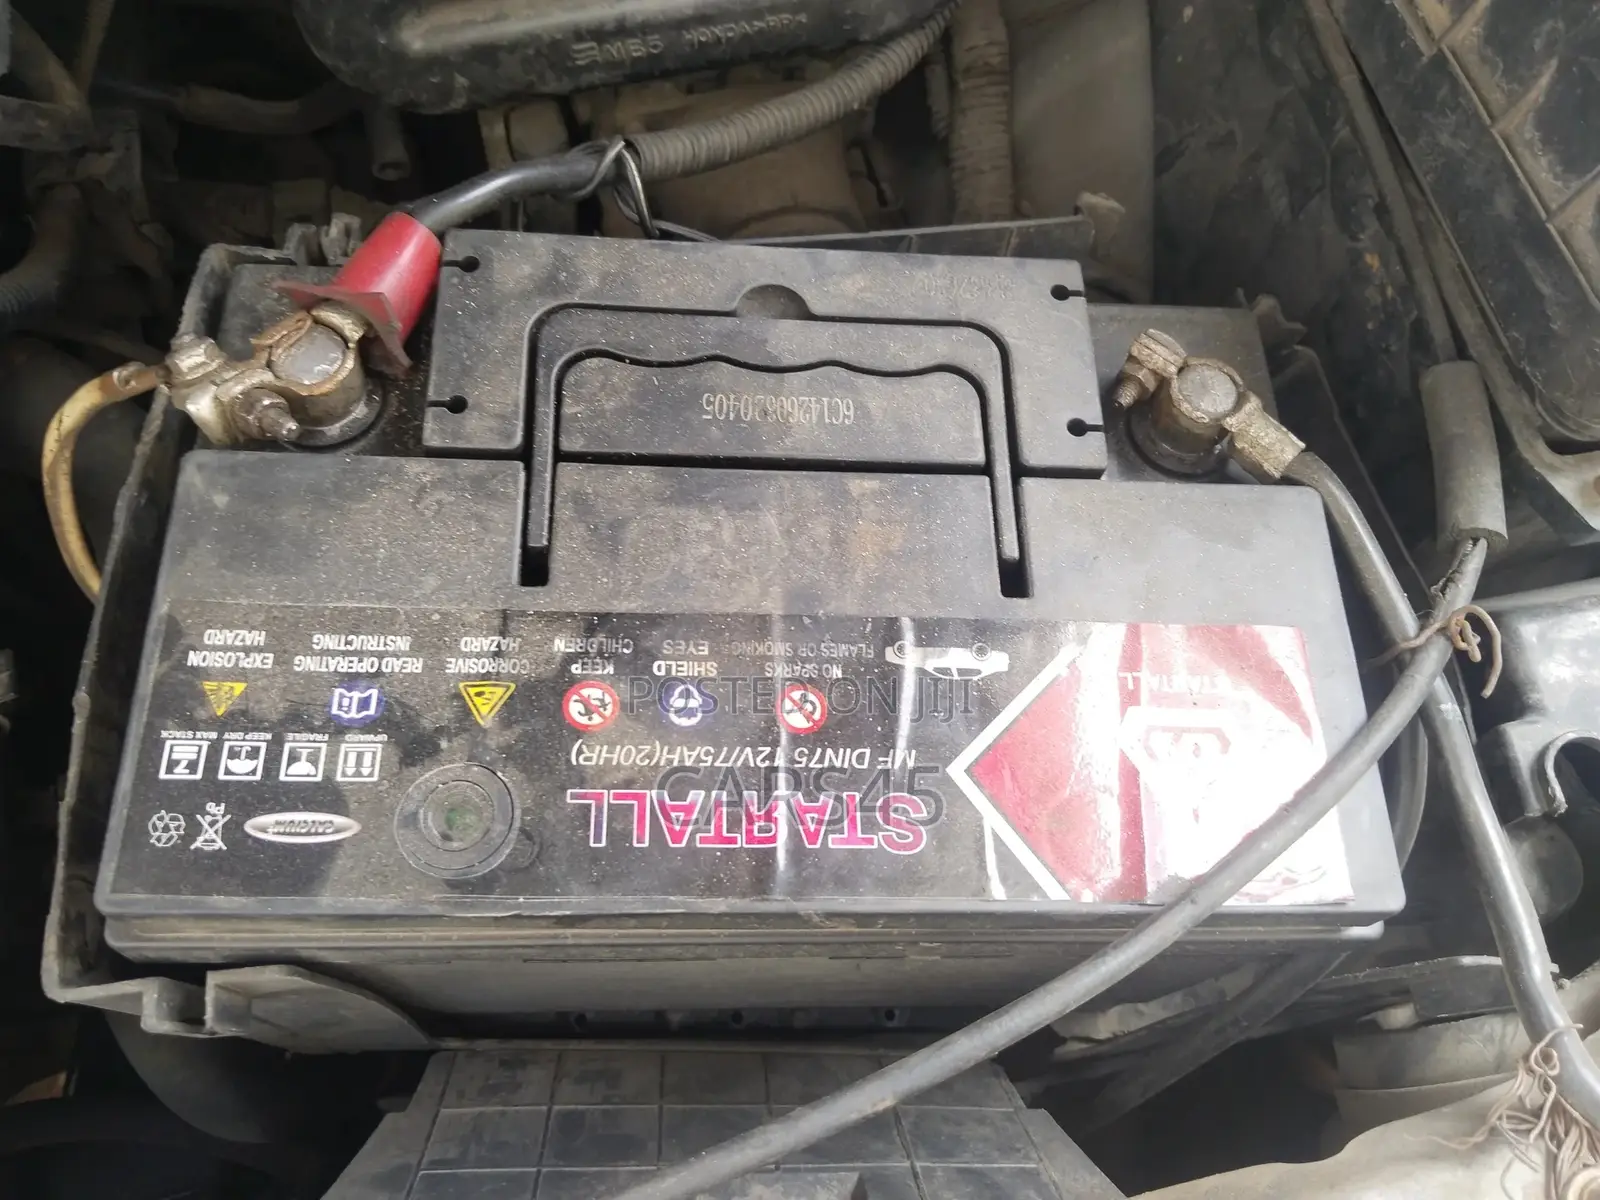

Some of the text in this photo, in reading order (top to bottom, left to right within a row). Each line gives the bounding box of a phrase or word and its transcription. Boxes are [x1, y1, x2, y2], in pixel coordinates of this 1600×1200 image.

[204, 629, 267, 647] HAZARD
[311, 633, 412, 651] INSTRUCTING
[460, 636, 521, 653] HAZARD
[553, 637, 634, 656] CHILDREN
[662, 639, 709, 657] EYES
[730, 640, 874, 657] FLAMES OR SMOKING
[187, 650, 274, 669] EXPLOSION
[293, 654, 423, 673] READ OPERATING
[445, 657, 530, 674] CORROSIVE
[570, 659, 615, 675] KEEP
[652, 660, 719, 677] SHIELD
[764, 661, 843, 678] NO SPARKS
[160, 730, 218, 740] MAX STACK
[222, 731, 272, 741] KEEP DRY
[286, 732, 330, 741] FRAGILE
[343, 732, 388, 742] UPWARD
[569, 738, 917, 769] MF DIN75 12V/75AH(20HR)
[205, 801, 226, 814] Pb
[566, 788, 928, 855] STARTALL
